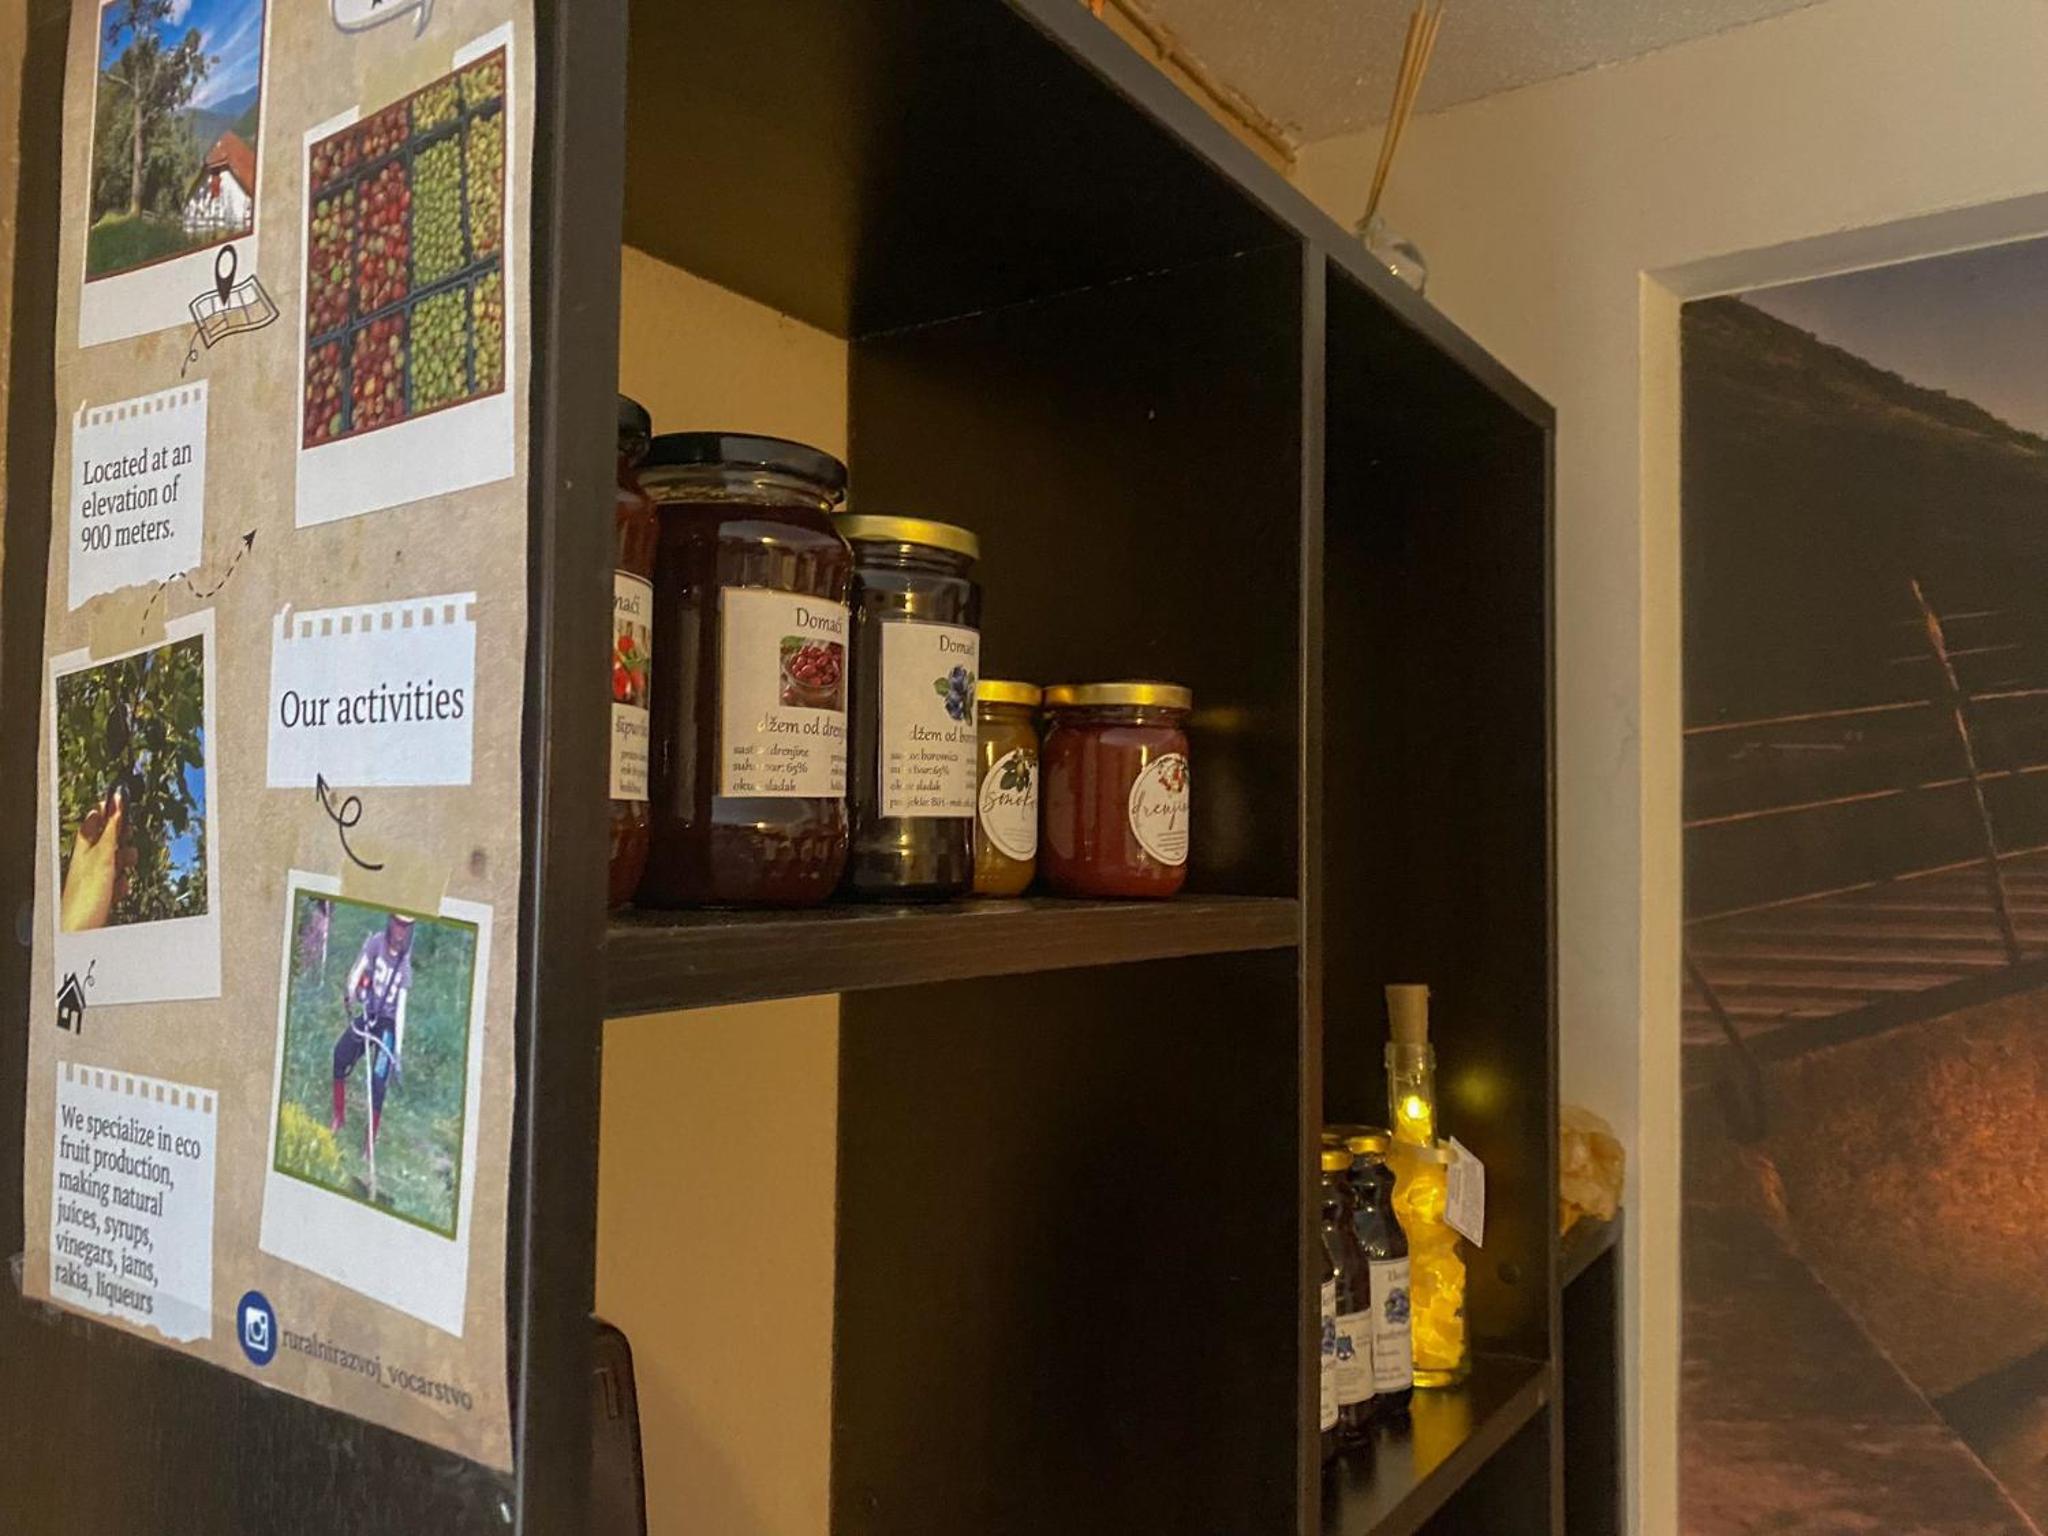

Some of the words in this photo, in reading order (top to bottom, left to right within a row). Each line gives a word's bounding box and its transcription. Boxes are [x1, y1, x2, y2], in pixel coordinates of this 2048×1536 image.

[82, 448, 148, 485] Located
[152, 447, 168, 472] at
[172, 444, 192, 467] an
[82, 485, 158, 518] elevation
[162, 473, 181, 503] of
[81, 524, 111, 552] 900
[115, 519, 175, 547] meters.
[280, 690, 330, 728] Our
[337, 679, 464, 725] activities
[803, 716, 820, 734] od
[944, 721, 958, 742] od
[61, 1104, 83, 1131] We
[86, 1115, 155, 1148] specialize
[157, 1125, 172, 1152] in
[175, 1136, 201, 1160] eco
[60, 1134, 90, 1165] fruit
[93, 1147, 174, 1192] production,
[58, 1170, 110, 1207] making
[112, 1186, 163, 1217] natural
[56, 1197, 101, 1236] juices,
[103, 1215, 153, 1252] syrups,
[55, 1230, 118, 1273] vinegars,
[120, 1247, 158, 1288] jams,
[55, 1261, 92, 1298] rakia,
[96, 1271, 154, 1314] liqueurs
